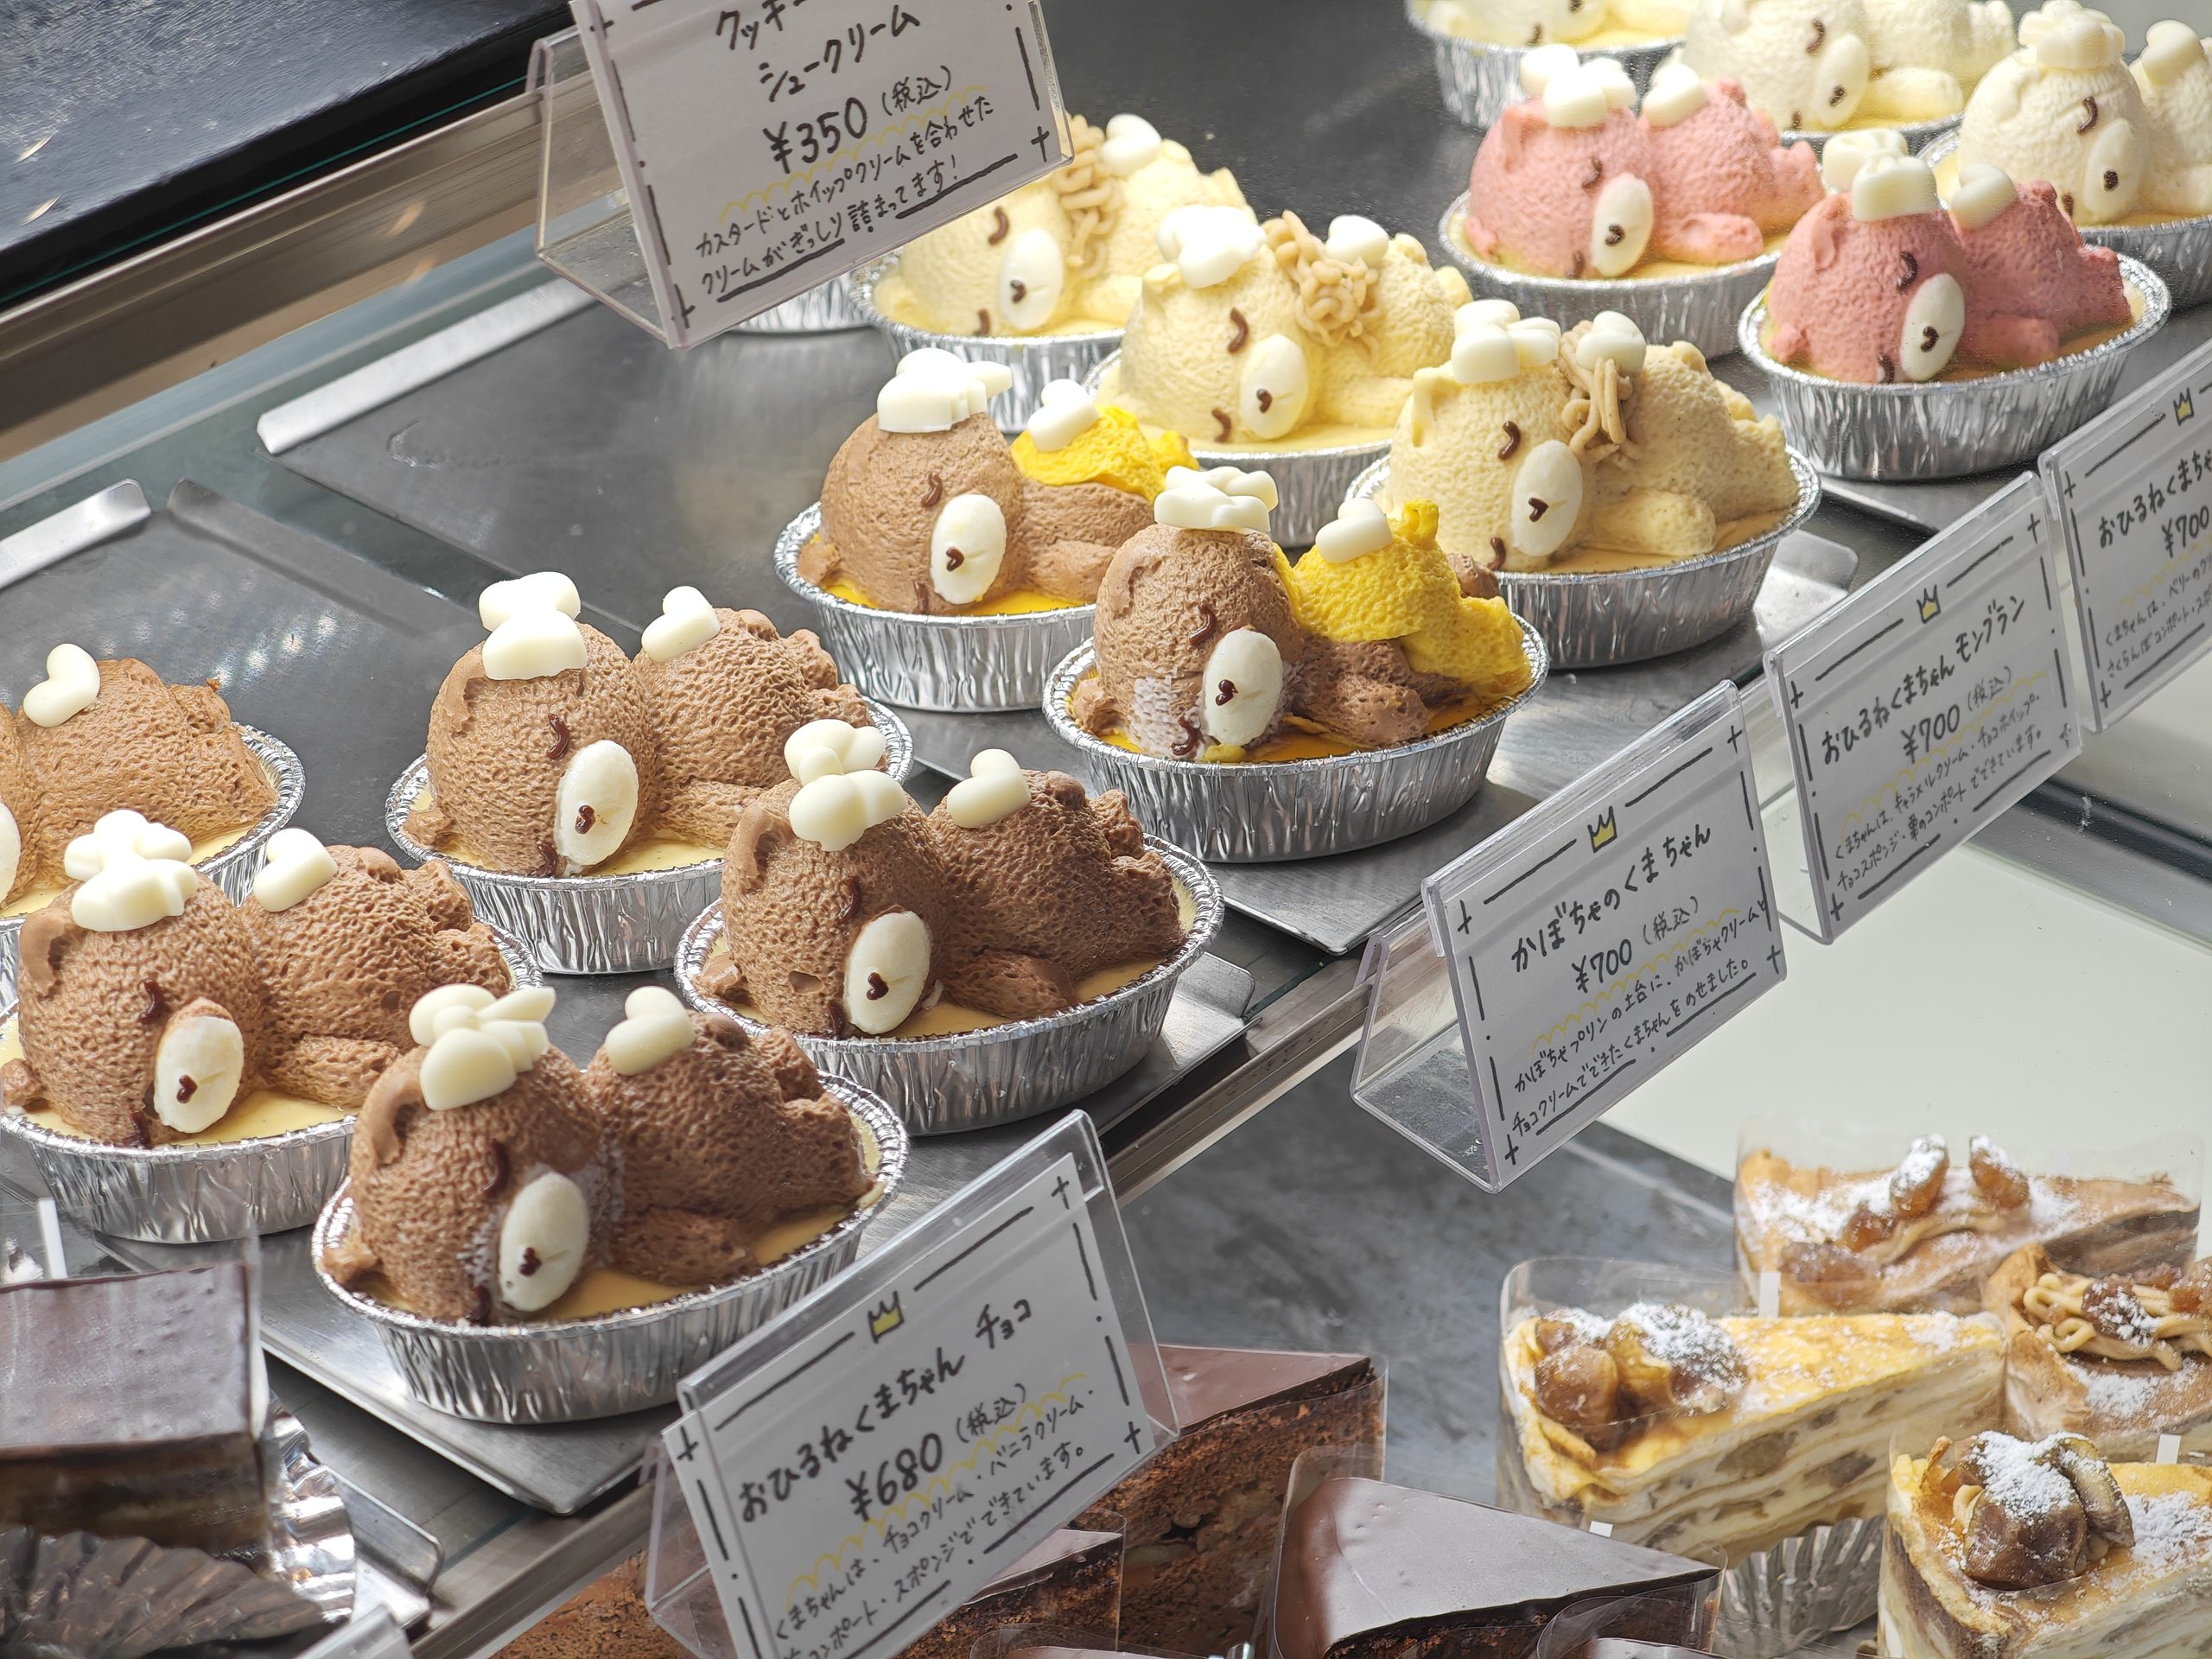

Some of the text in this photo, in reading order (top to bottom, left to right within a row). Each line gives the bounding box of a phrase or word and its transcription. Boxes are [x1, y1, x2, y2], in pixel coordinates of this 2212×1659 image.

[760, 4, 920, 102] シュークリーム
[696, 96, 994, 257] カスタードとホイップクリームを合わせた
[762, 65, 951, 174] ¥350 (税込)
[2161, 505, 2209, 559] ¥700
[1821, 596, 2024, 765] おひるねくまちゃん モンブラン
[1900, 704, 1961, 764] ¥700
[1511, 824, 1710, 973] かぼちゃのくまちゃん
[1571, 895, 1698, 993] ¥700 (税込)
[739, 1299, 1032, 1523] おひるねくまちゃん チョコ
[845, 1382, 1027, 1522] ¥680 (税込)
